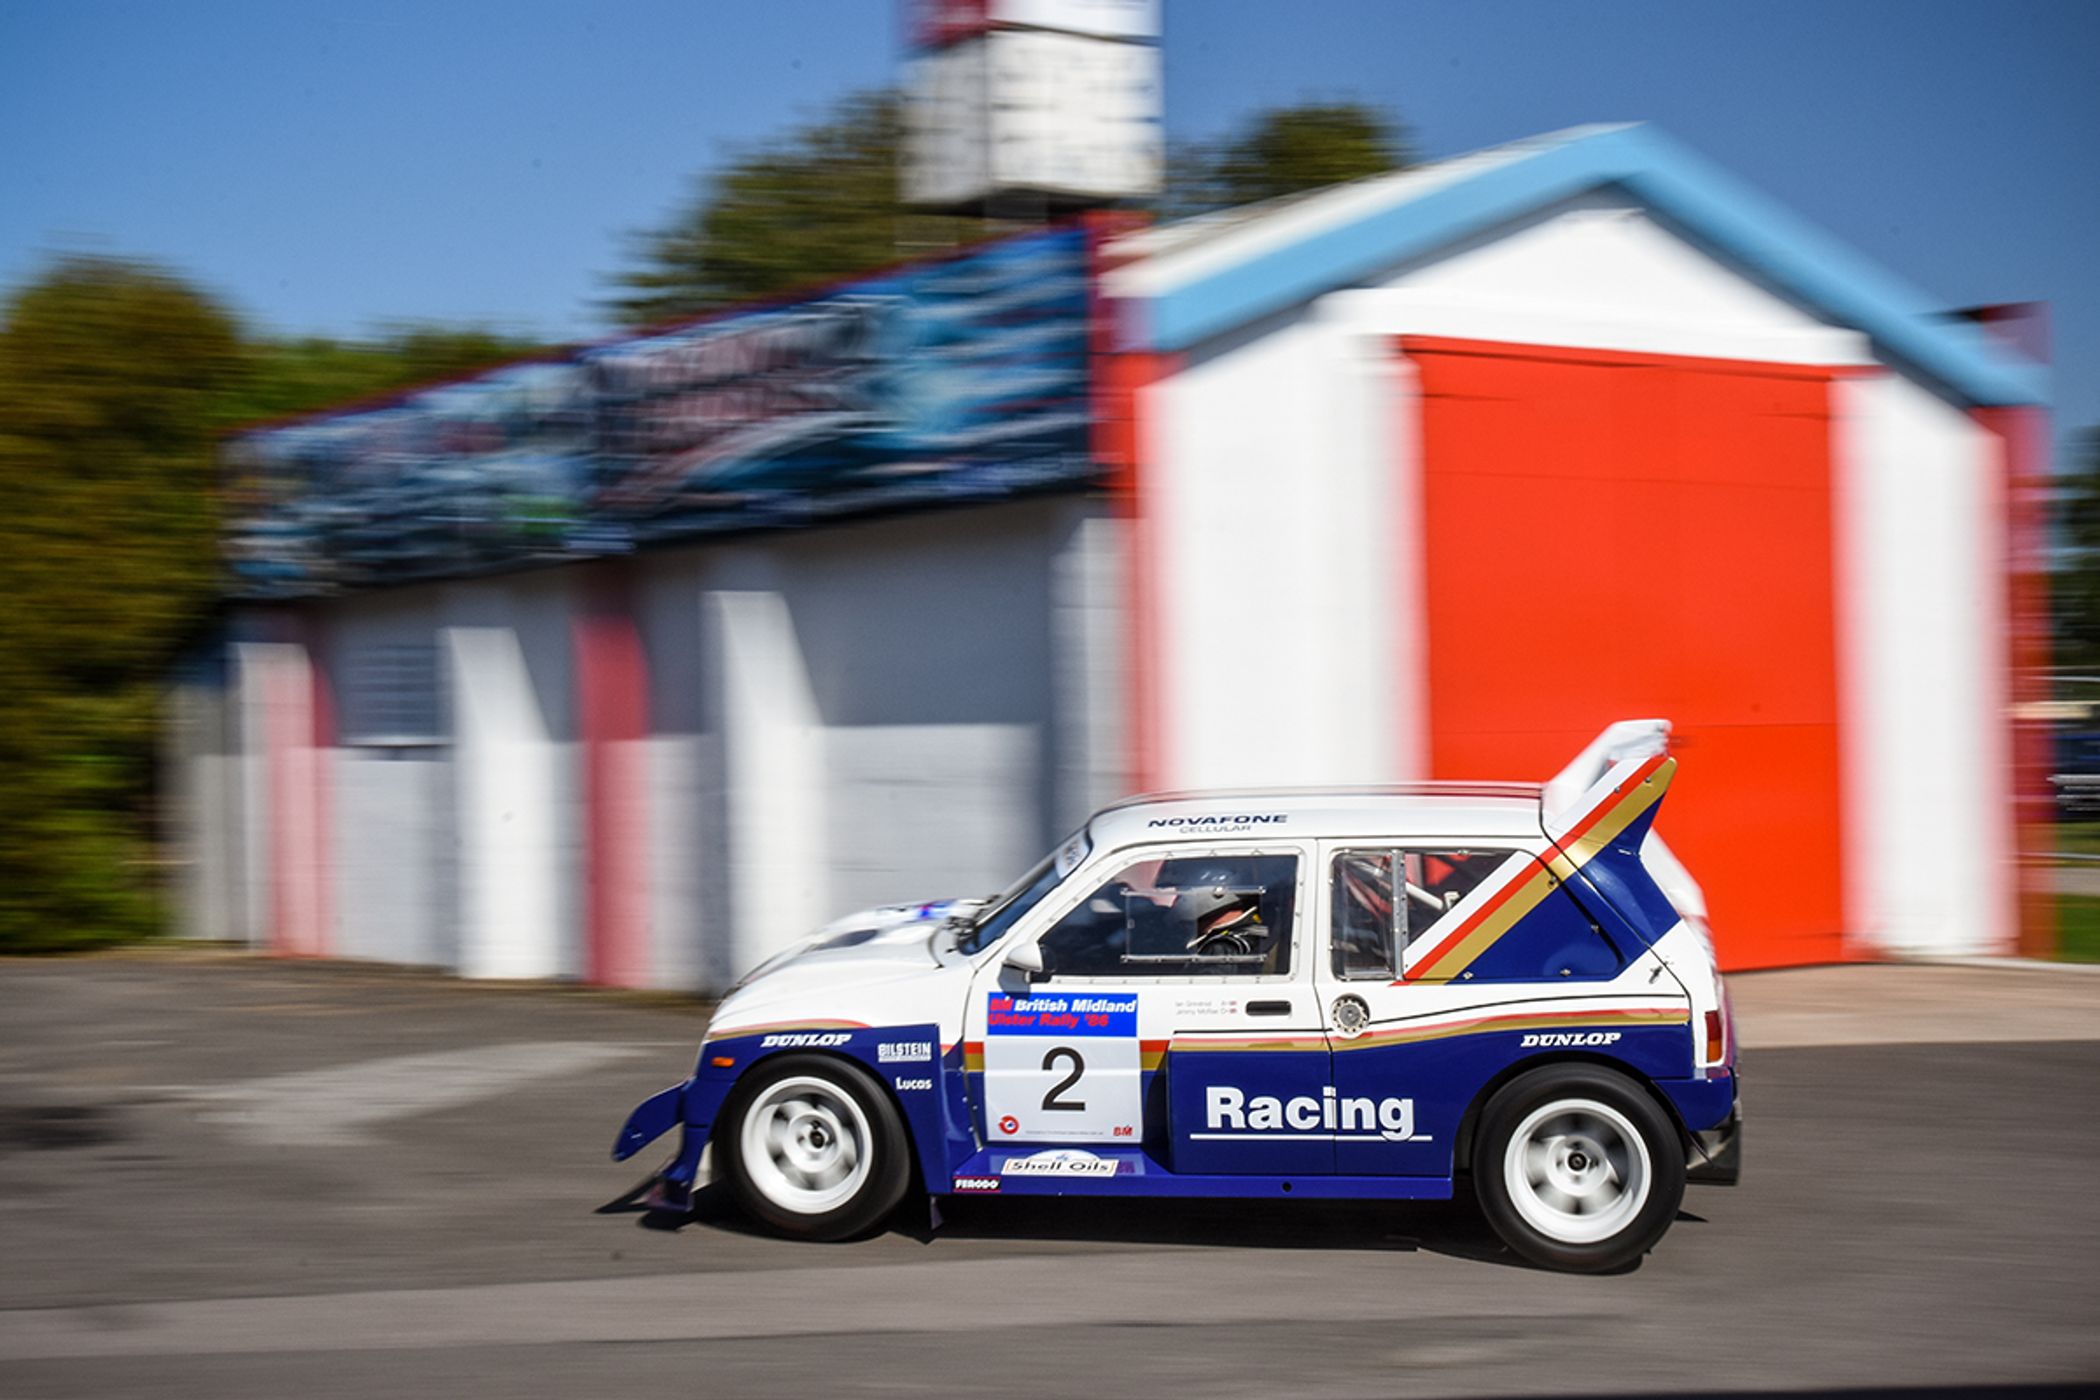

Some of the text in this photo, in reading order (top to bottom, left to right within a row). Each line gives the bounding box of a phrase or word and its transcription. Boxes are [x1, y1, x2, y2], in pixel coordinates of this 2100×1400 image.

[1148, 814, 1288, 828] NOVAFONE
[1180, 824, 1252, 834] CELLULAR
[1014, 999, 1069, 1012] British
[1071, 999, 1137, 1013] Midland
[988, 1013, 1110, 1029] Ulster Rally '86
[760, 1034, 852, 1048] DUNLOP
[1520, 1032, 1622, 1048] DUNLOP
[878, 1043, 932, 1057] BILSTEIN
[895, 1076, 933, 1091] Lucas
[1042, 1046, 1086, 1111] 2
[1205, 1086, 1415, 1142] Racing
[1012, 1161, 1062, 1171] Shell
[1069, 1161, 1109, 1172] Oils
